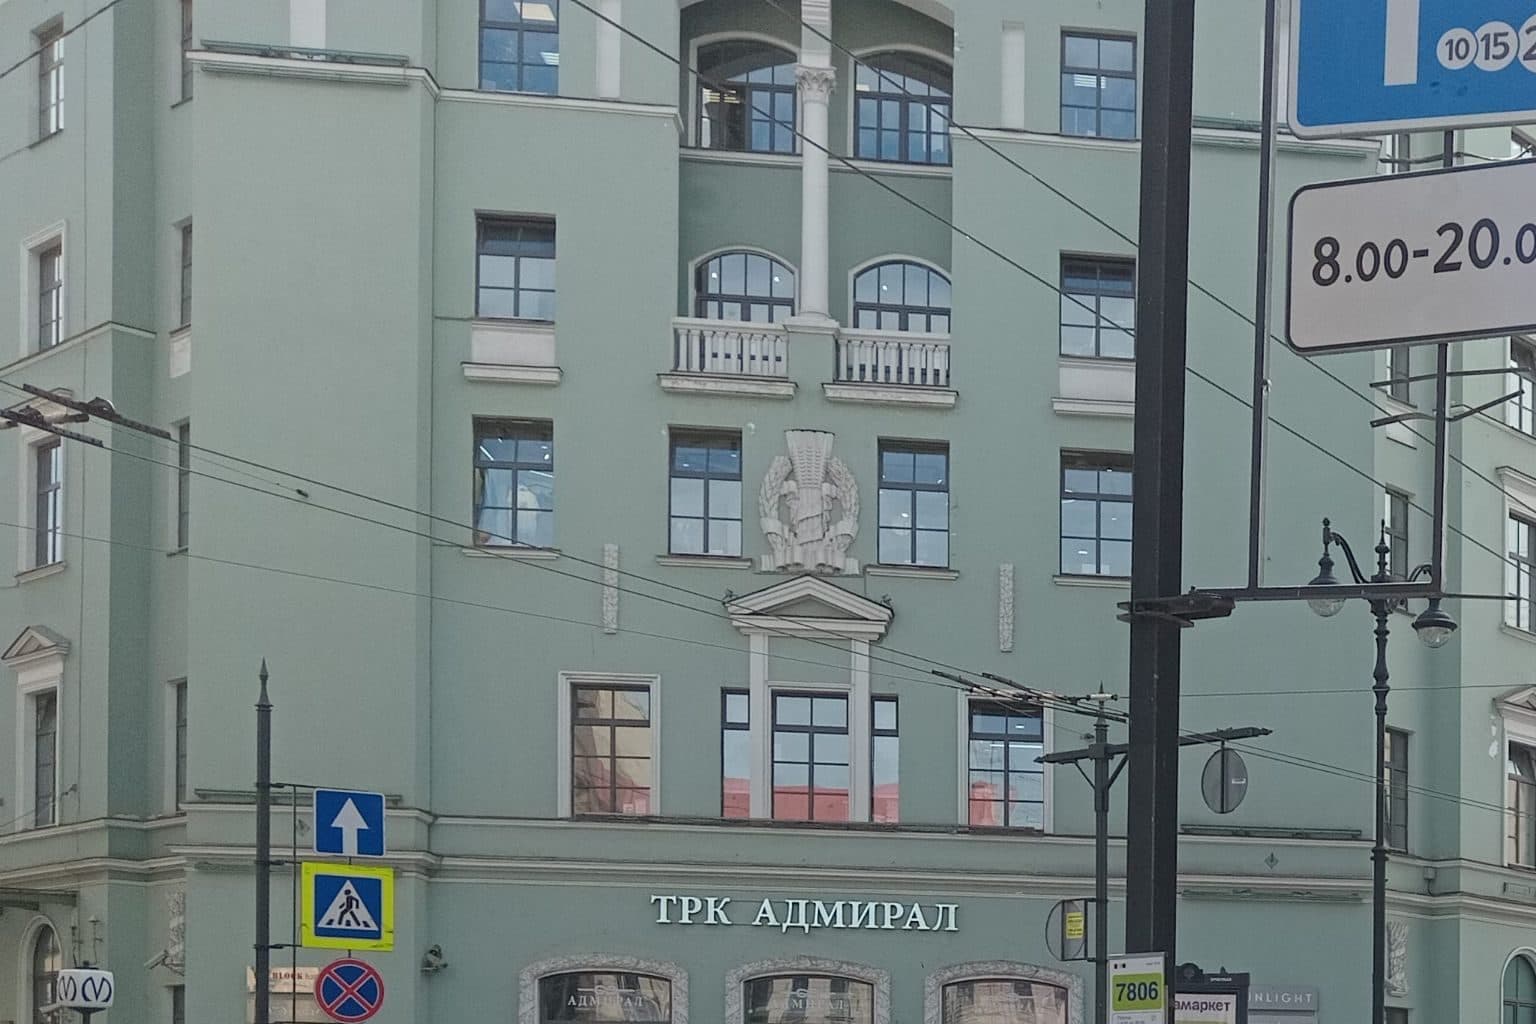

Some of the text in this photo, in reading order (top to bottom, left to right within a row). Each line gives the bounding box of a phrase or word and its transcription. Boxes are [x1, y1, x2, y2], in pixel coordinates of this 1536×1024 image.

[1445, 36, 1470, 61] 10
[1480, 31, 1510, 61] 15
[650, 894, 959, 934] ТРК АДМИРАЛ
[1115, 981, 1159, 1002] 7806
[1248, 992, 1313, 1004] NLIGHT
[1174, 1000, 1231, 1013] амаркет
